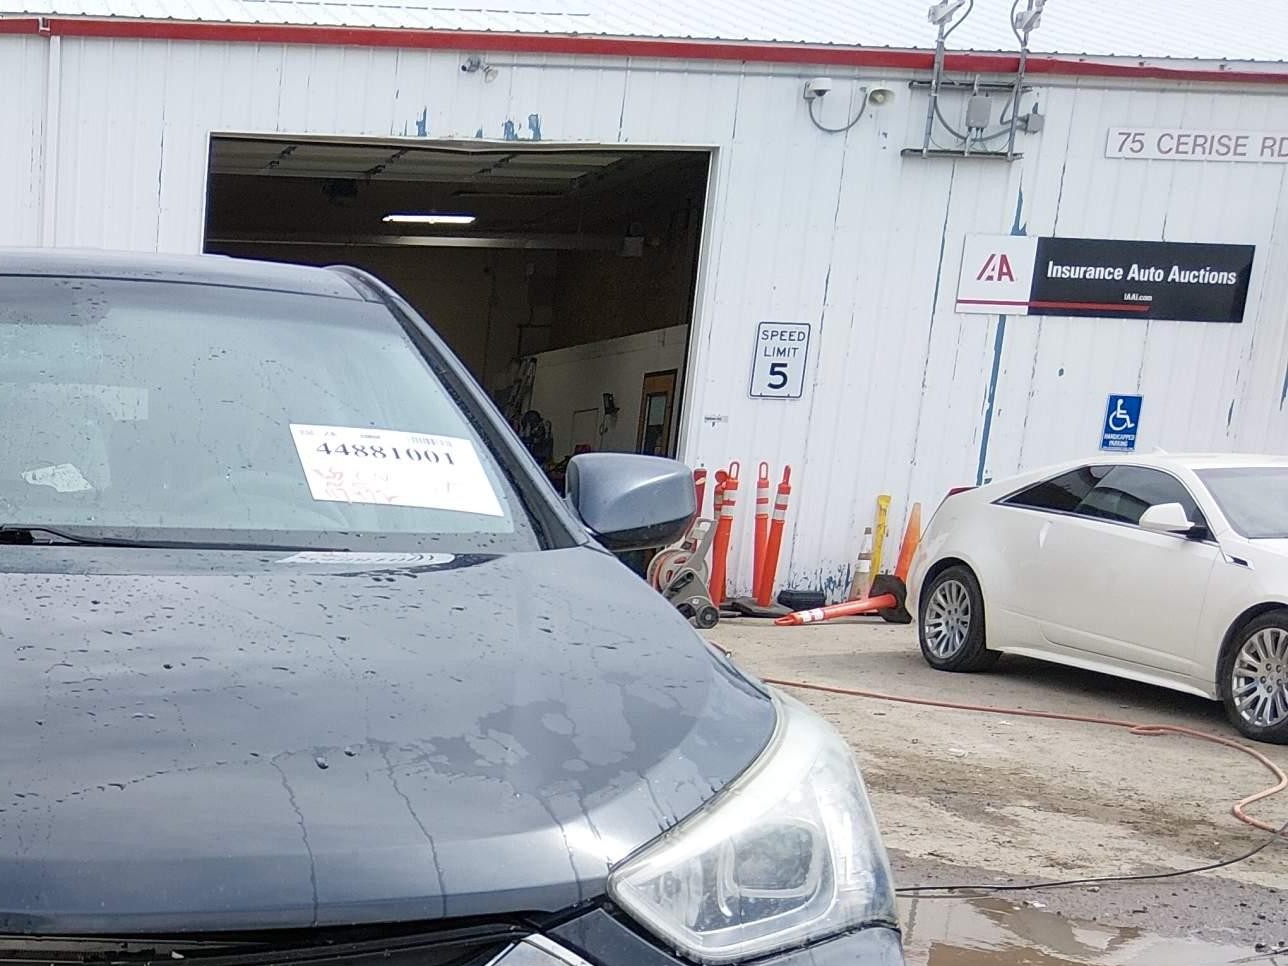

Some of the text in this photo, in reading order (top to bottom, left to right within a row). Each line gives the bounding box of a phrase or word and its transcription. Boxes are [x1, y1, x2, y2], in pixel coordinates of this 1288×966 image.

[1117, 132, 1145, 153] 75
[1156, 133, 1250, 156] CERISE
[1047, 260, 1237, 285] Insurance Auto Auctions
[760, 330, 806, 341] SPEED
[764, 346, 799, 357] LIMIT
[767, 362, 788, 389] 5
[316, 442, 455, 465] 44881001
